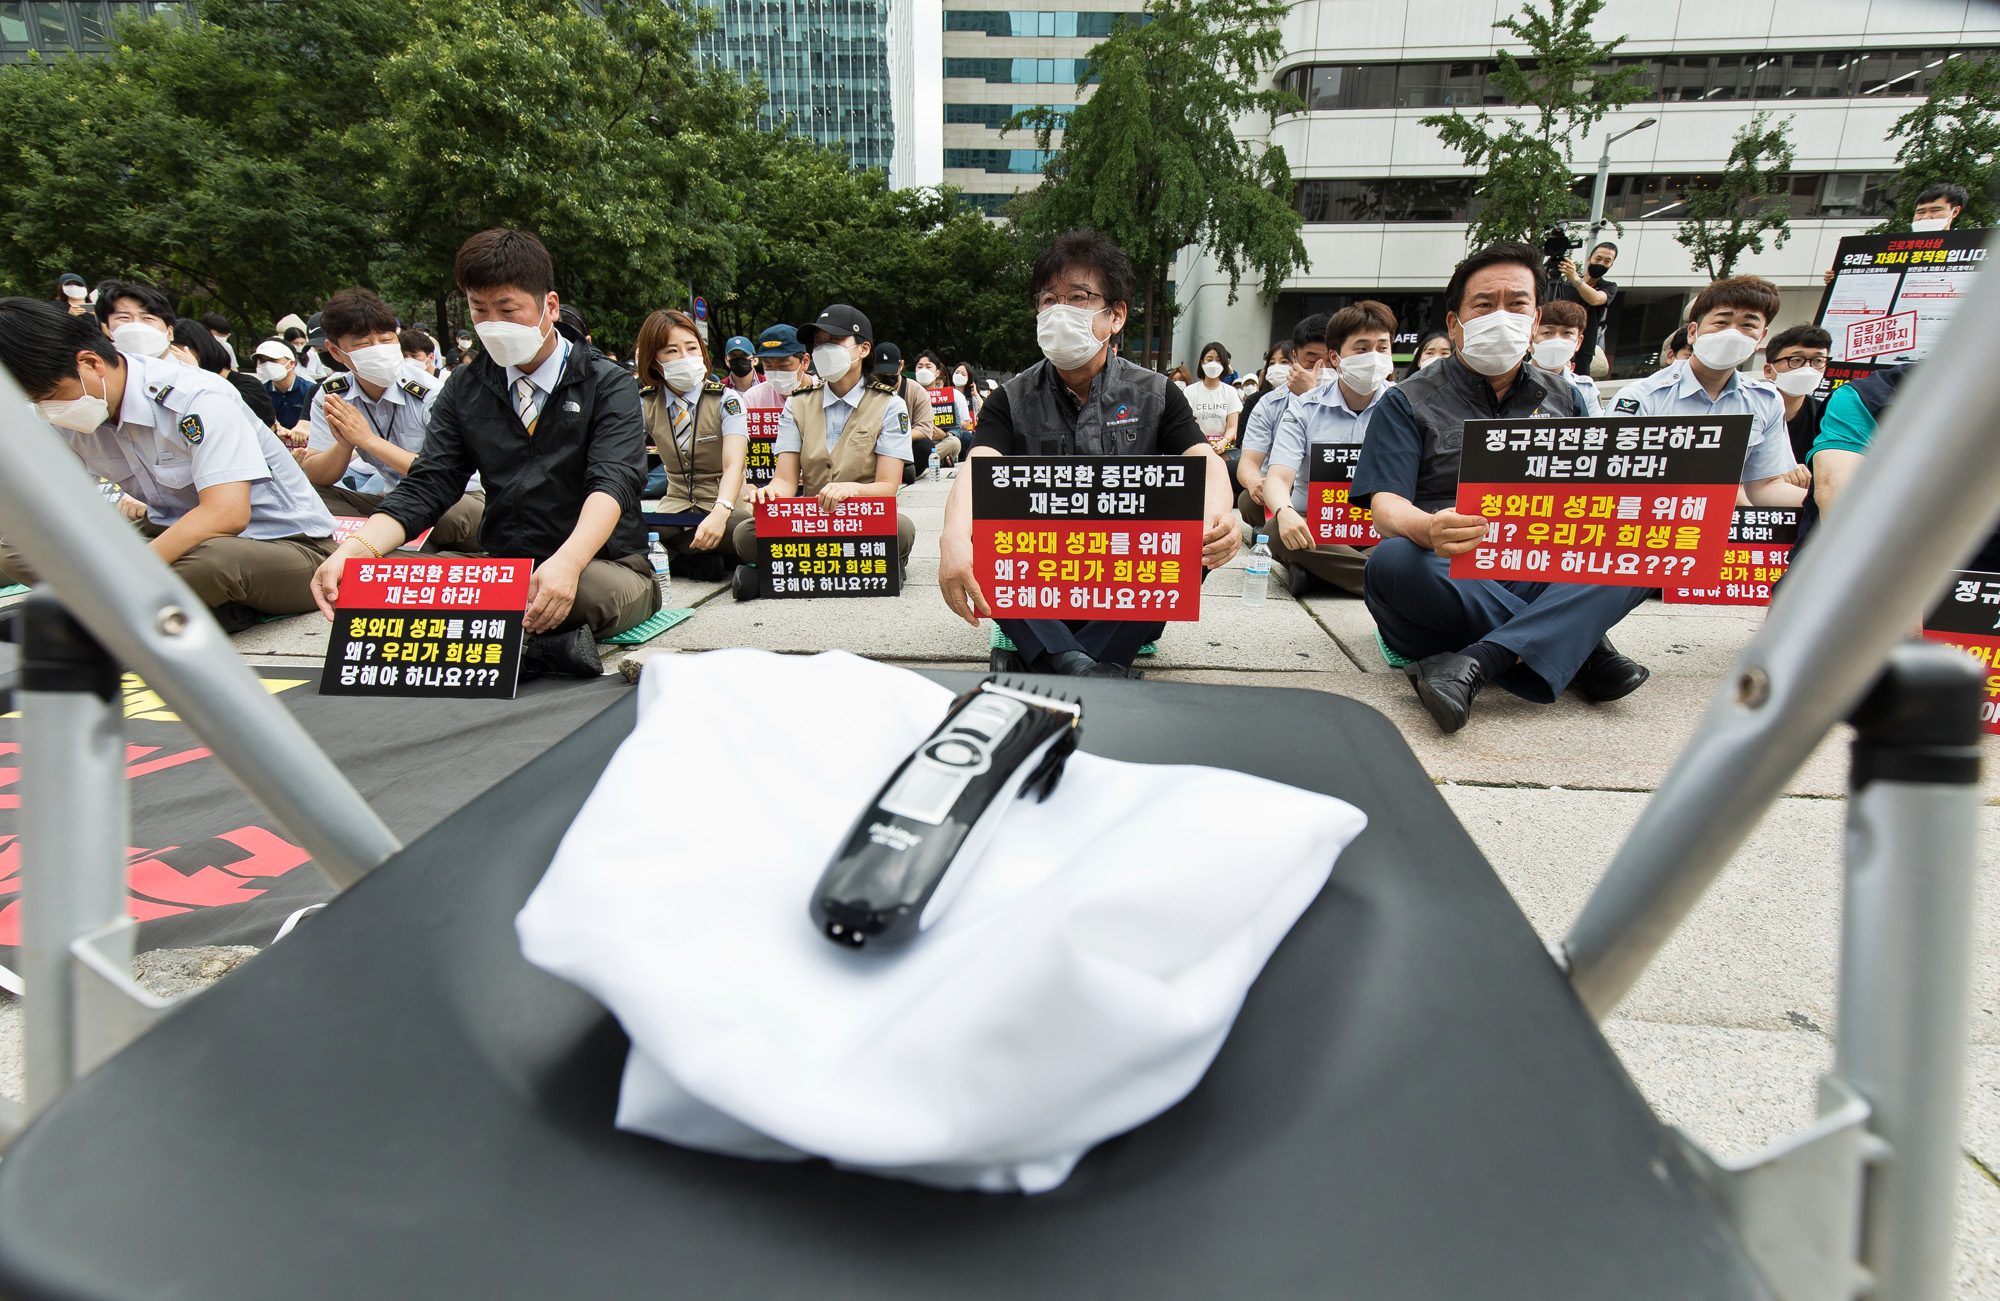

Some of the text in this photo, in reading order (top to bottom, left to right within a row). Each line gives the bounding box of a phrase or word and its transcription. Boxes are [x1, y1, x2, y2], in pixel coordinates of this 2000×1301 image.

[1888, 239, 1944, 250] 근로계약서상
[1843, 254, 1873, 266] 우리는
[1874, 252, 1908, 264] 자회사
[1854, 319, 1897, 337] 근로기간
[1395, 334, 1418, 343] AFE
[1853, 328, 1908, 348] 퇴직일까지
[1486, 426, 1723, 452] 정규직전환 중단하고
[1524, 454, 1667, 478] 재논의 하라!
[991, 465, 1185, 488] 정규직전환 중단하고
[835, 502, 885, 516] 중단하고
[1029, 492, 1145, 514] 재논의 하라!
[1480, 494, 1554, 518] 청와대
[1563, 496, 1642, 520] 성과를
[1652, 496, 1708, 520] 위해
[1321, 507, 1344, 521] 왜?
[1744, 511, 1797, 525] 중단하고
[791, 519, 862, 533] 재논의 하라!
[1320, 524, 1363, 538] 당해야
[1742, 527, 1773, 540] 하라!
[994, 531, 1181, 555] 청와대 성과를 위해
[1526, 523, 1606, 547] 우리가
[1616, 525, 1702, 550] 희생을
[771, 542, 886, 558] 청와대 성과를 위해
[1724, 550, 1764, 565] 성과를
[772, 560, 887, 575] 왜? 우리가 희생을
[995, 559, 1181, 584] 왜? 우리가 희생을
[1475, 548, 1696, 577] 당해야 하나요???
[359, 565, 514, 583] 정규직전환 중단하고
[1720, 567, 1749, 581] 리가
[772, 577, 888, 592] 당해야 하나요???
[1726, 584, 1769, 598] 하나요
[385, 586, 480, 604] 재논의 하라!
[995, 586, 1180, 609] 당해야 하나요???
[350, 617, 506, 639] 청와대 성과를 위해
[344, 642, 503, 663] 왜? 우리가 희생을
[340, 665, 500, 686] 당해야 하나요???
